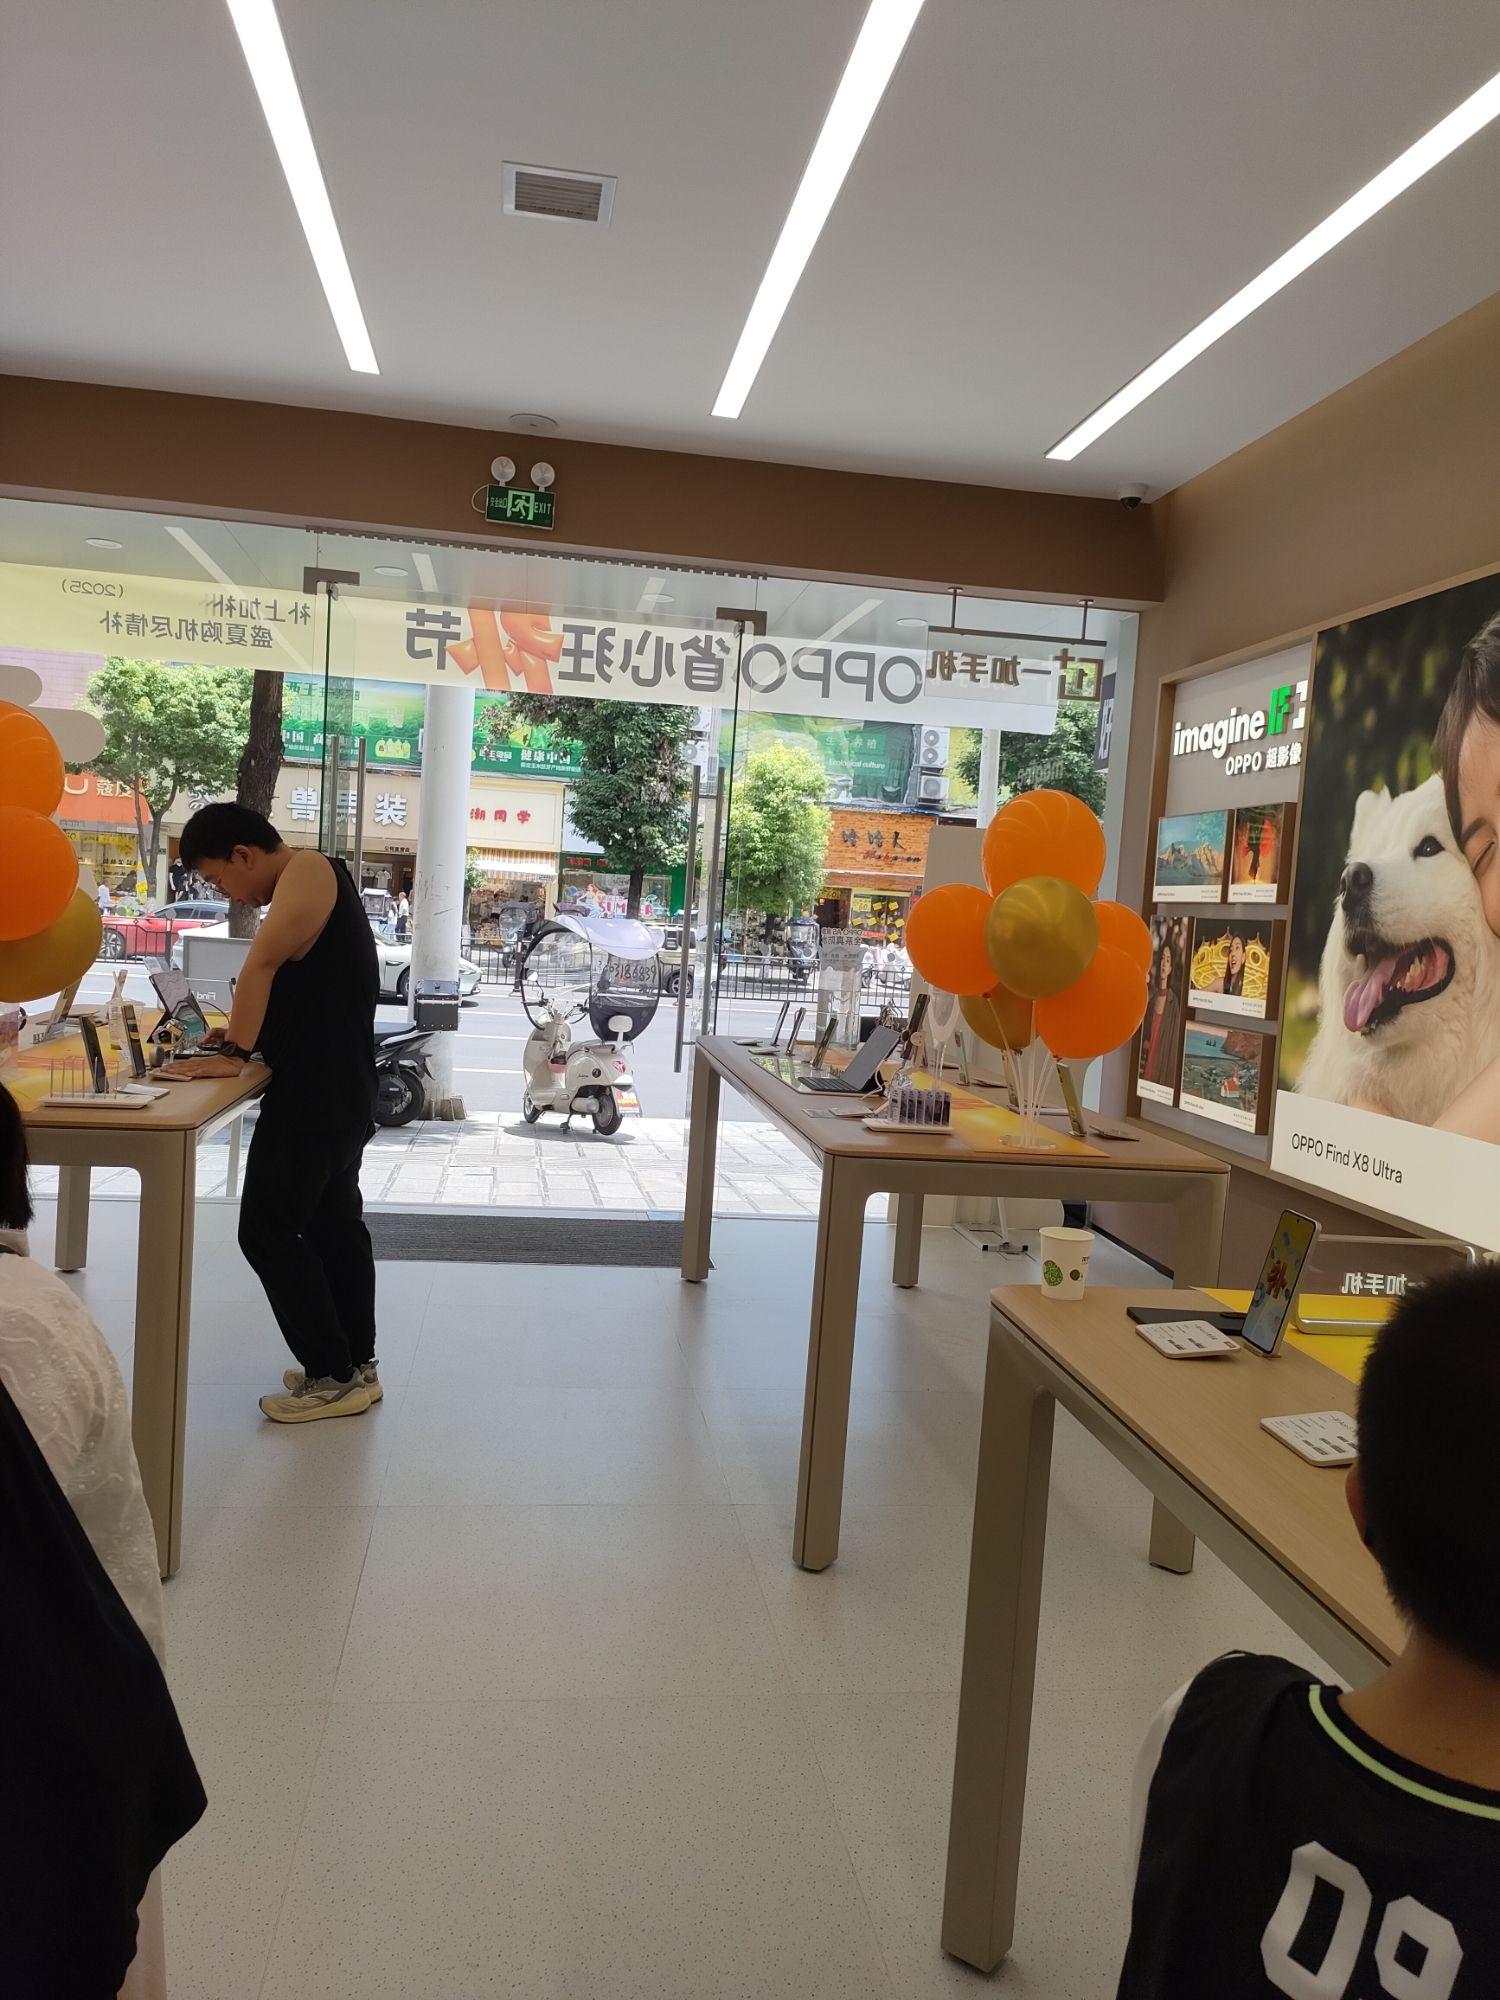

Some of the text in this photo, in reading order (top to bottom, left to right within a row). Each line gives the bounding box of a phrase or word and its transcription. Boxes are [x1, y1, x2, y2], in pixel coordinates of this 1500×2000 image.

[533, 501, 552, 515] EXIT
[1173, 706, 1265, 759] imagine
[828, 758, 886, 770] Ecological culture
[1225, 741, 1302, 776] OPPO 超影像
[1291, 1133, 1403, 1184] OPPO Find X8 Ultra
